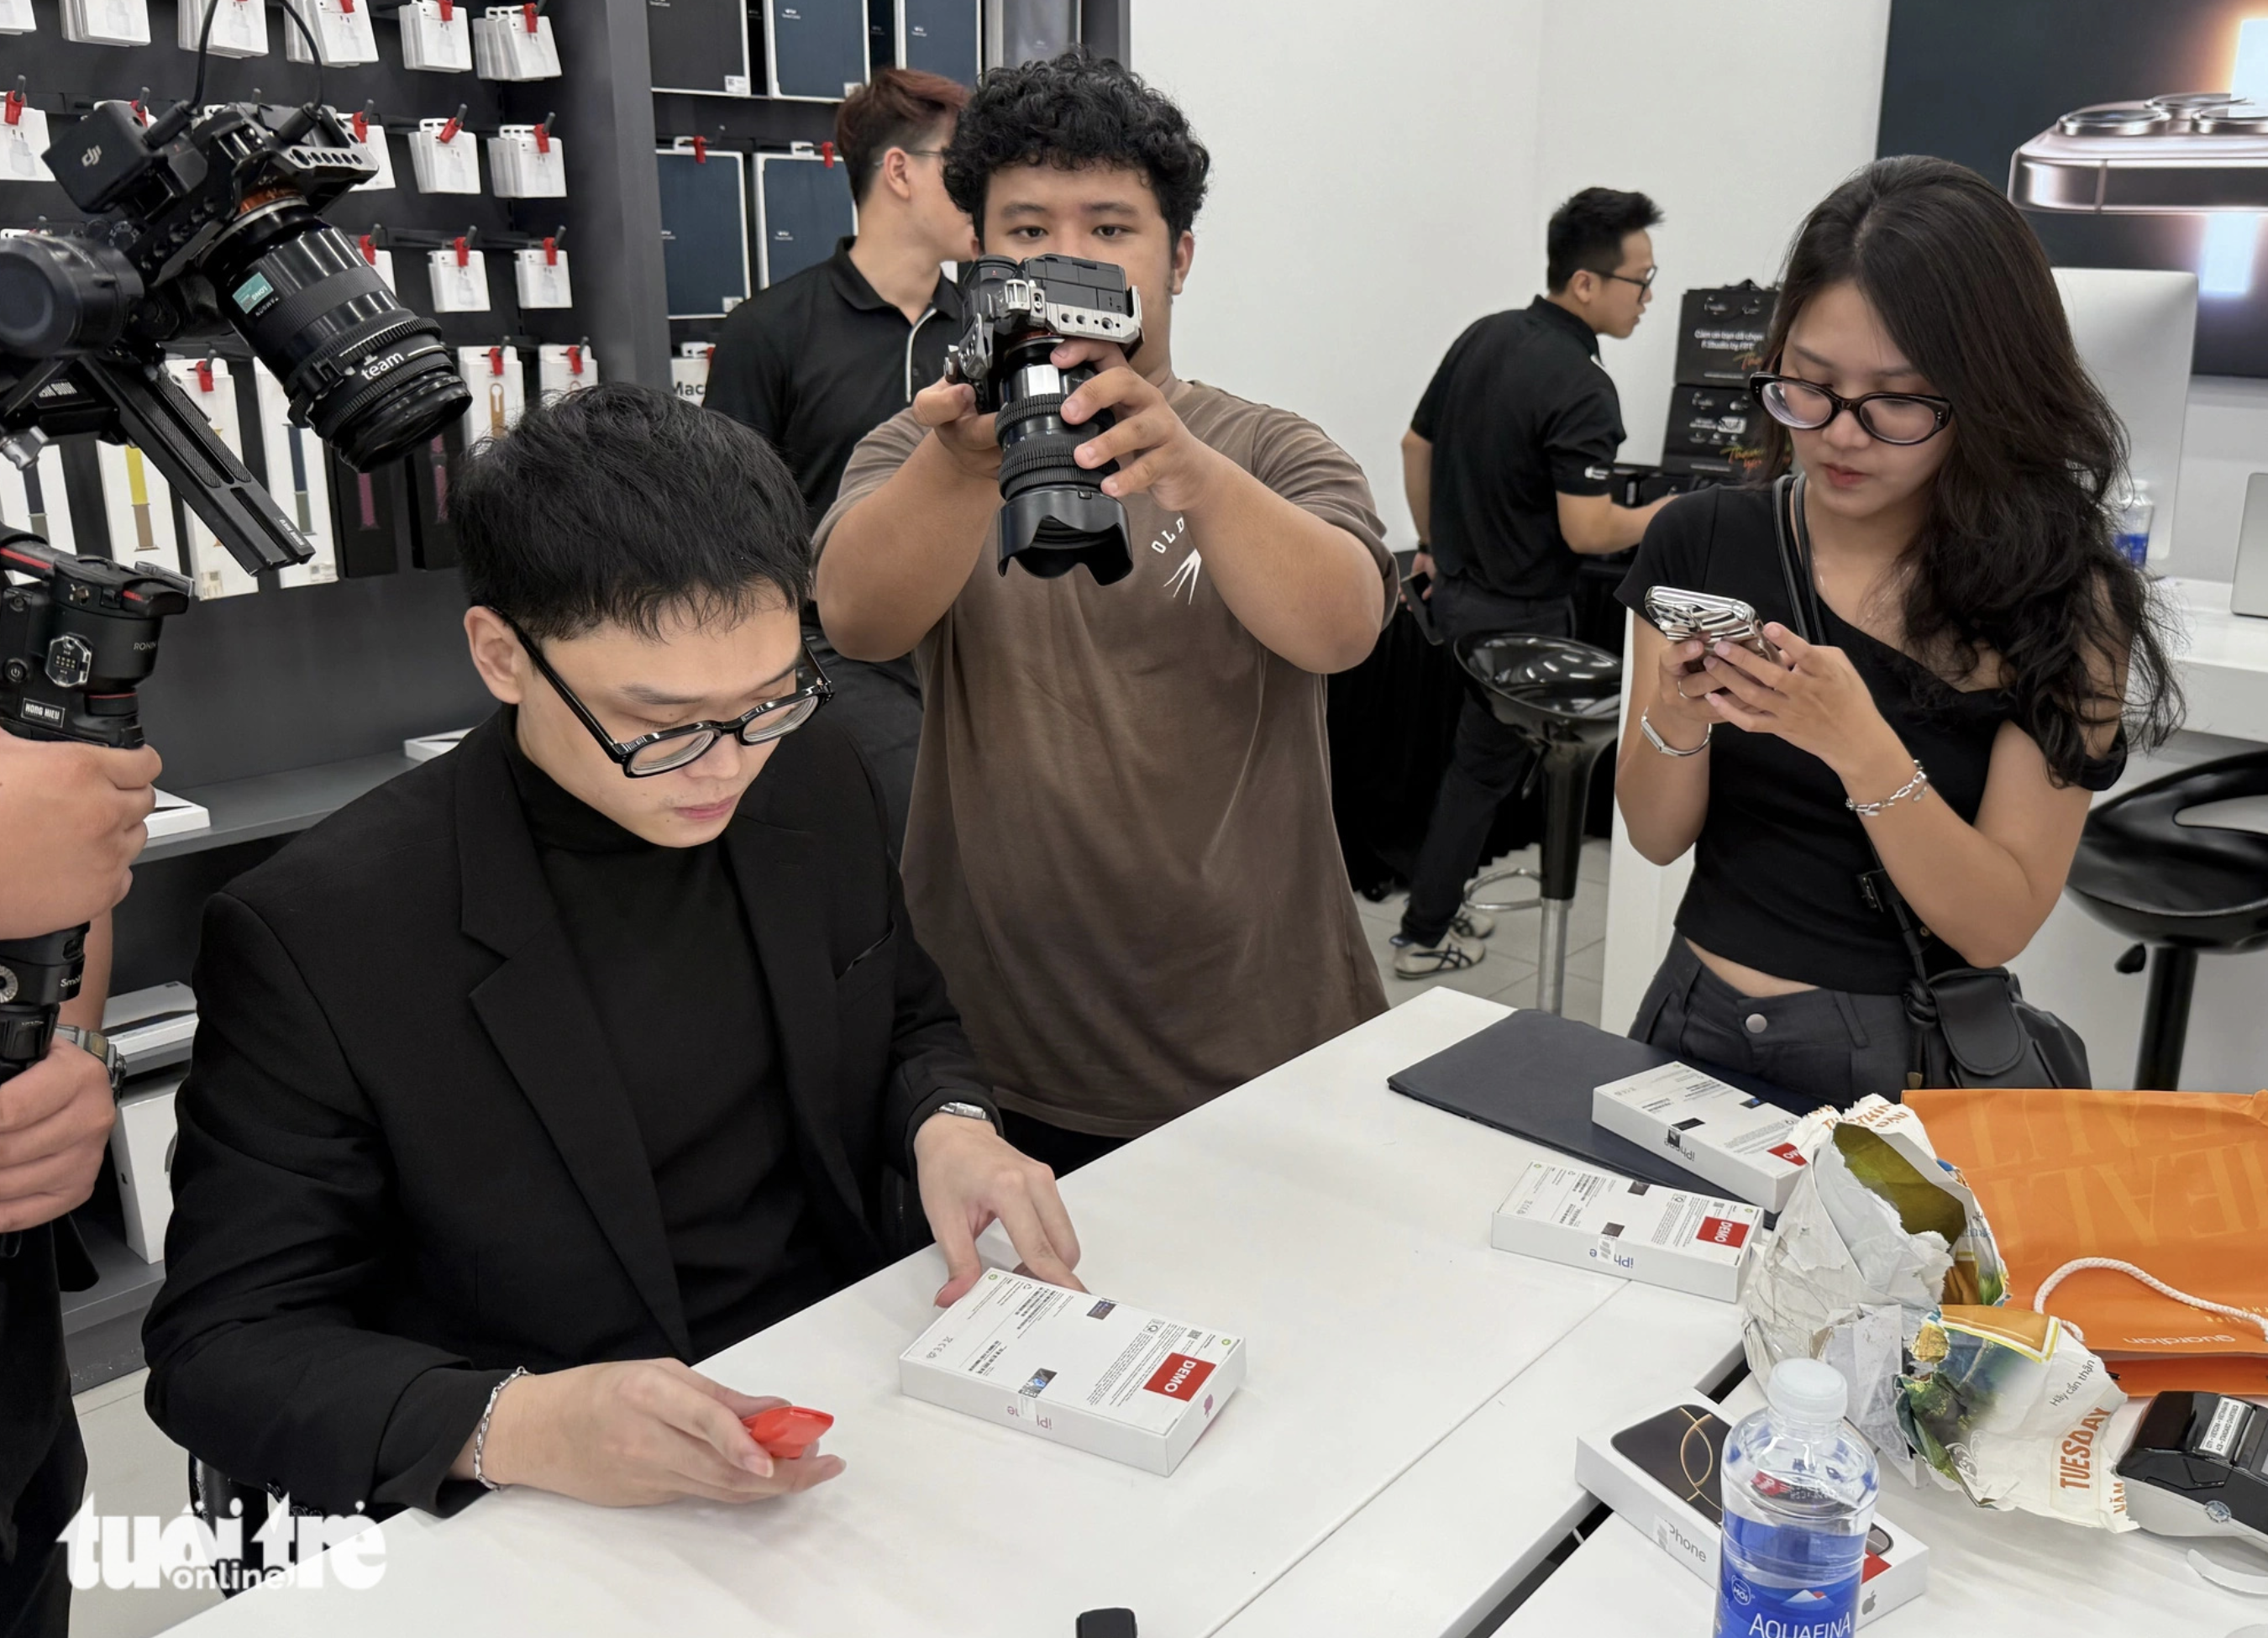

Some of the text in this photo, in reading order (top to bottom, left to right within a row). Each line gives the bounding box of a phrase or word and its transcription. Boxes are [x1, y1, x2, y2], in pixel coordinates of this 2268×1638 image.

[361, 352, 405, 381] team
[1714, 1221, 1733, 1242] DEMO
[1589, 1248, 1635, 1269] iPhe
[2123, 1334, 2237, 1346] guardian
[1164, 1359, 1197, 1393] DEMO
[2059, 1406, 2112, 1489] TUESDAY
[1749, 1612, 1851, 1638] AQUAFINA
